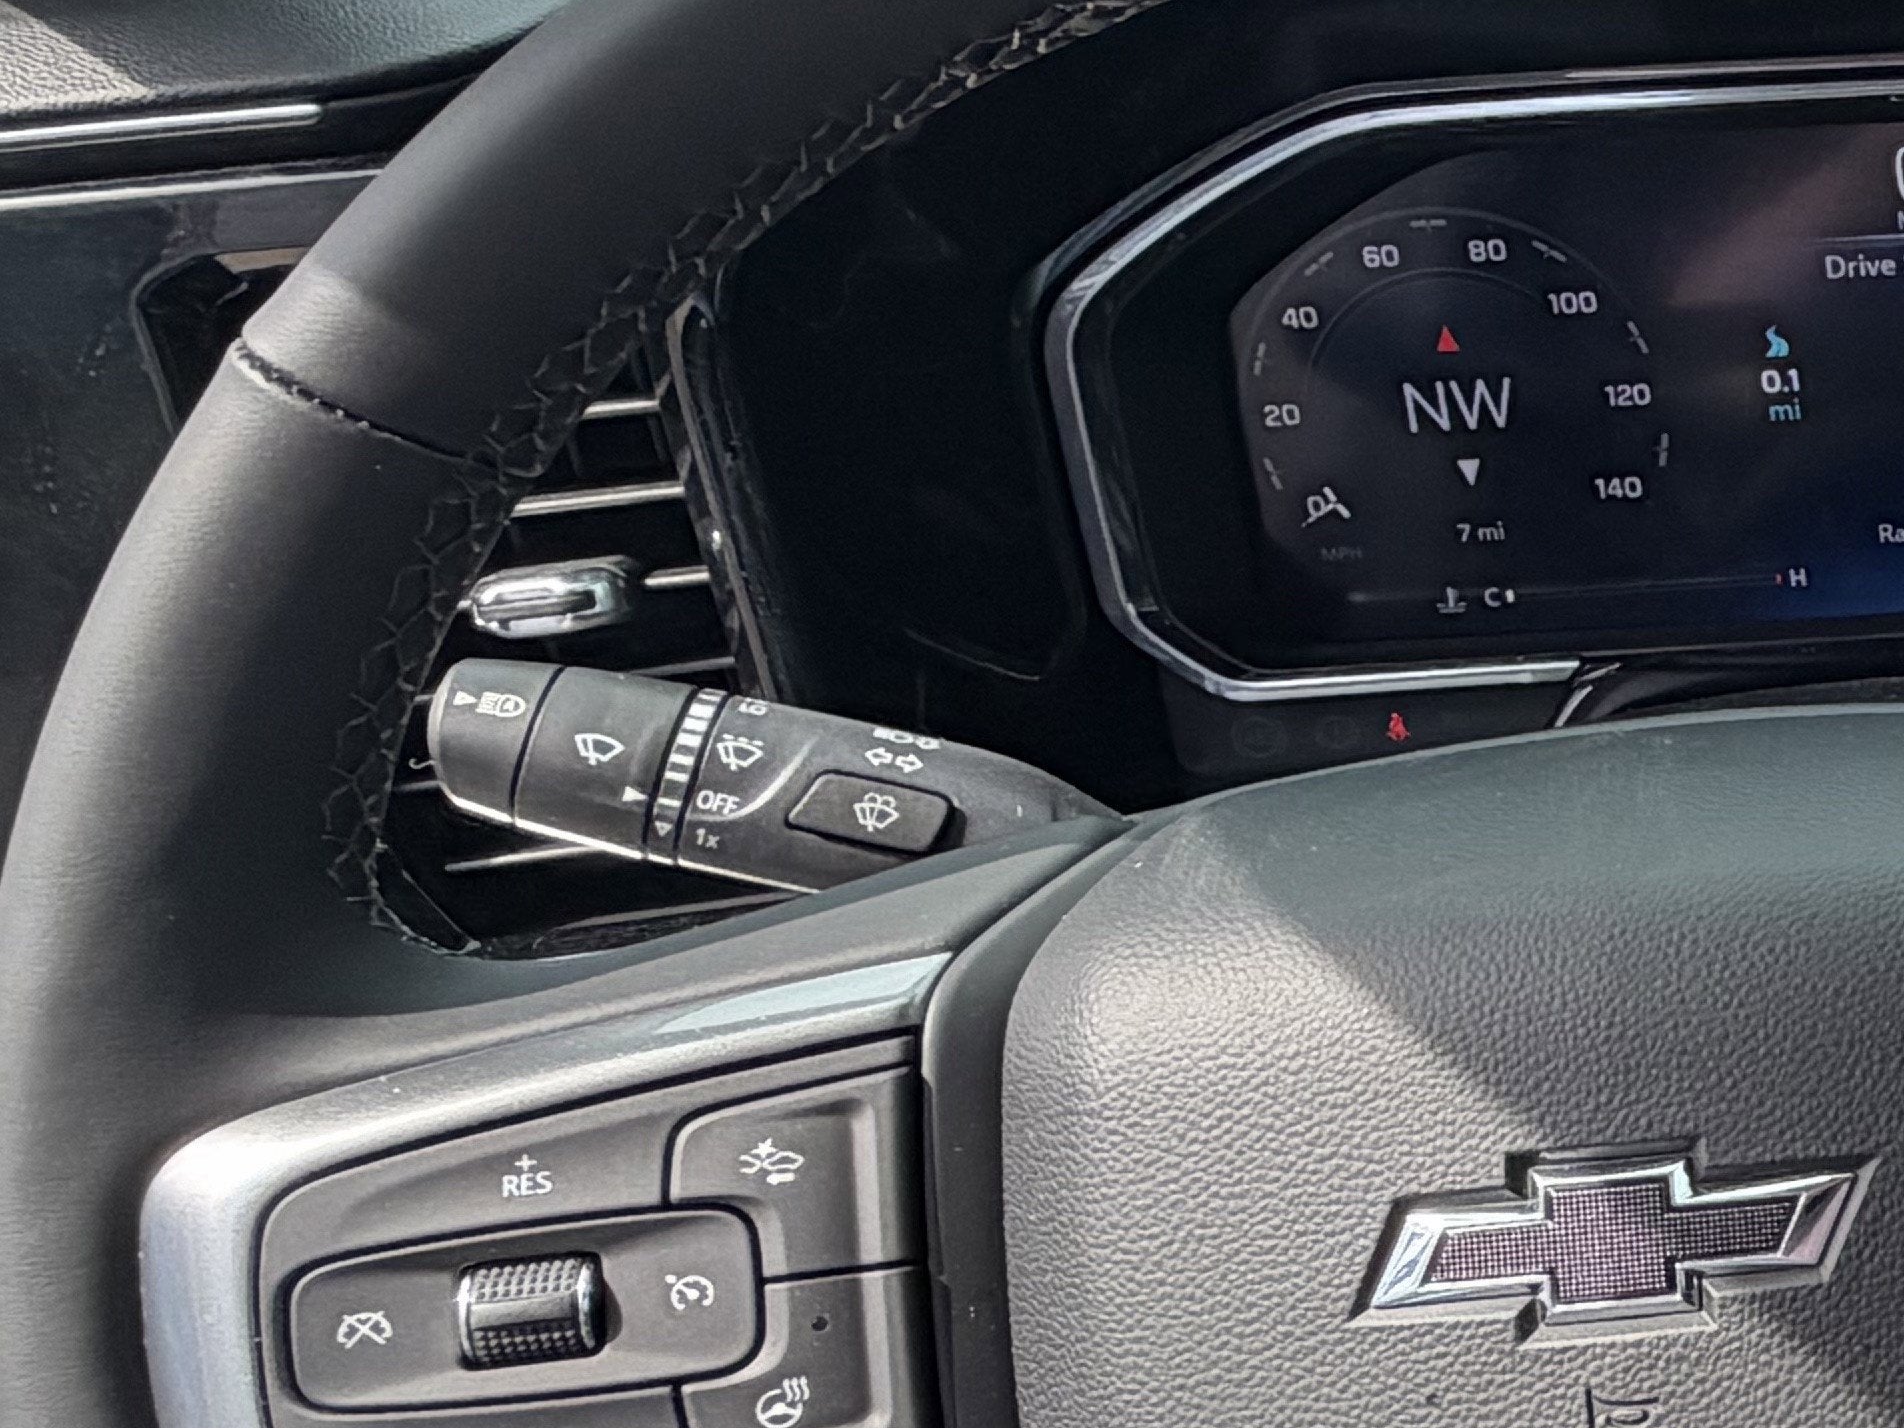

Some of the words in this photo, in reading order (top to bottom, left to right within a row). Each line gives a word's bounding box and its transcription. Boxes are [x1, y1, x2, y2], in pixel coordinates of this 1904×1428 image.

[1362, 244, 1400, 268] 60
[1467, 238, 1507, 262] 80
[1825, 256, 1896, 280] Drive
[1547, 291, 1598, 315] 100
[1281, 306, 1319, 330] 40
[1760, 368, 1799, 394] 0.1
[1402, 377, 1511, 433] NW
[1604, 383, 1651, 407] 120
[1263, 404, 1300, 427] 20
[1768, 398, 1801, 422] mi
[1594, 477, 1643, 500] 140
[1456, 524, 1471, 542] 7
[1477, 521, 1506, 542] mi
[1789, 569, 1808, 588] H
[1484, 587, 1501, 607] C
[695, 789, 740, 816] OFF
[694, 827, 719, 851] 1x
[502, 1171, 554, 1198] RES
